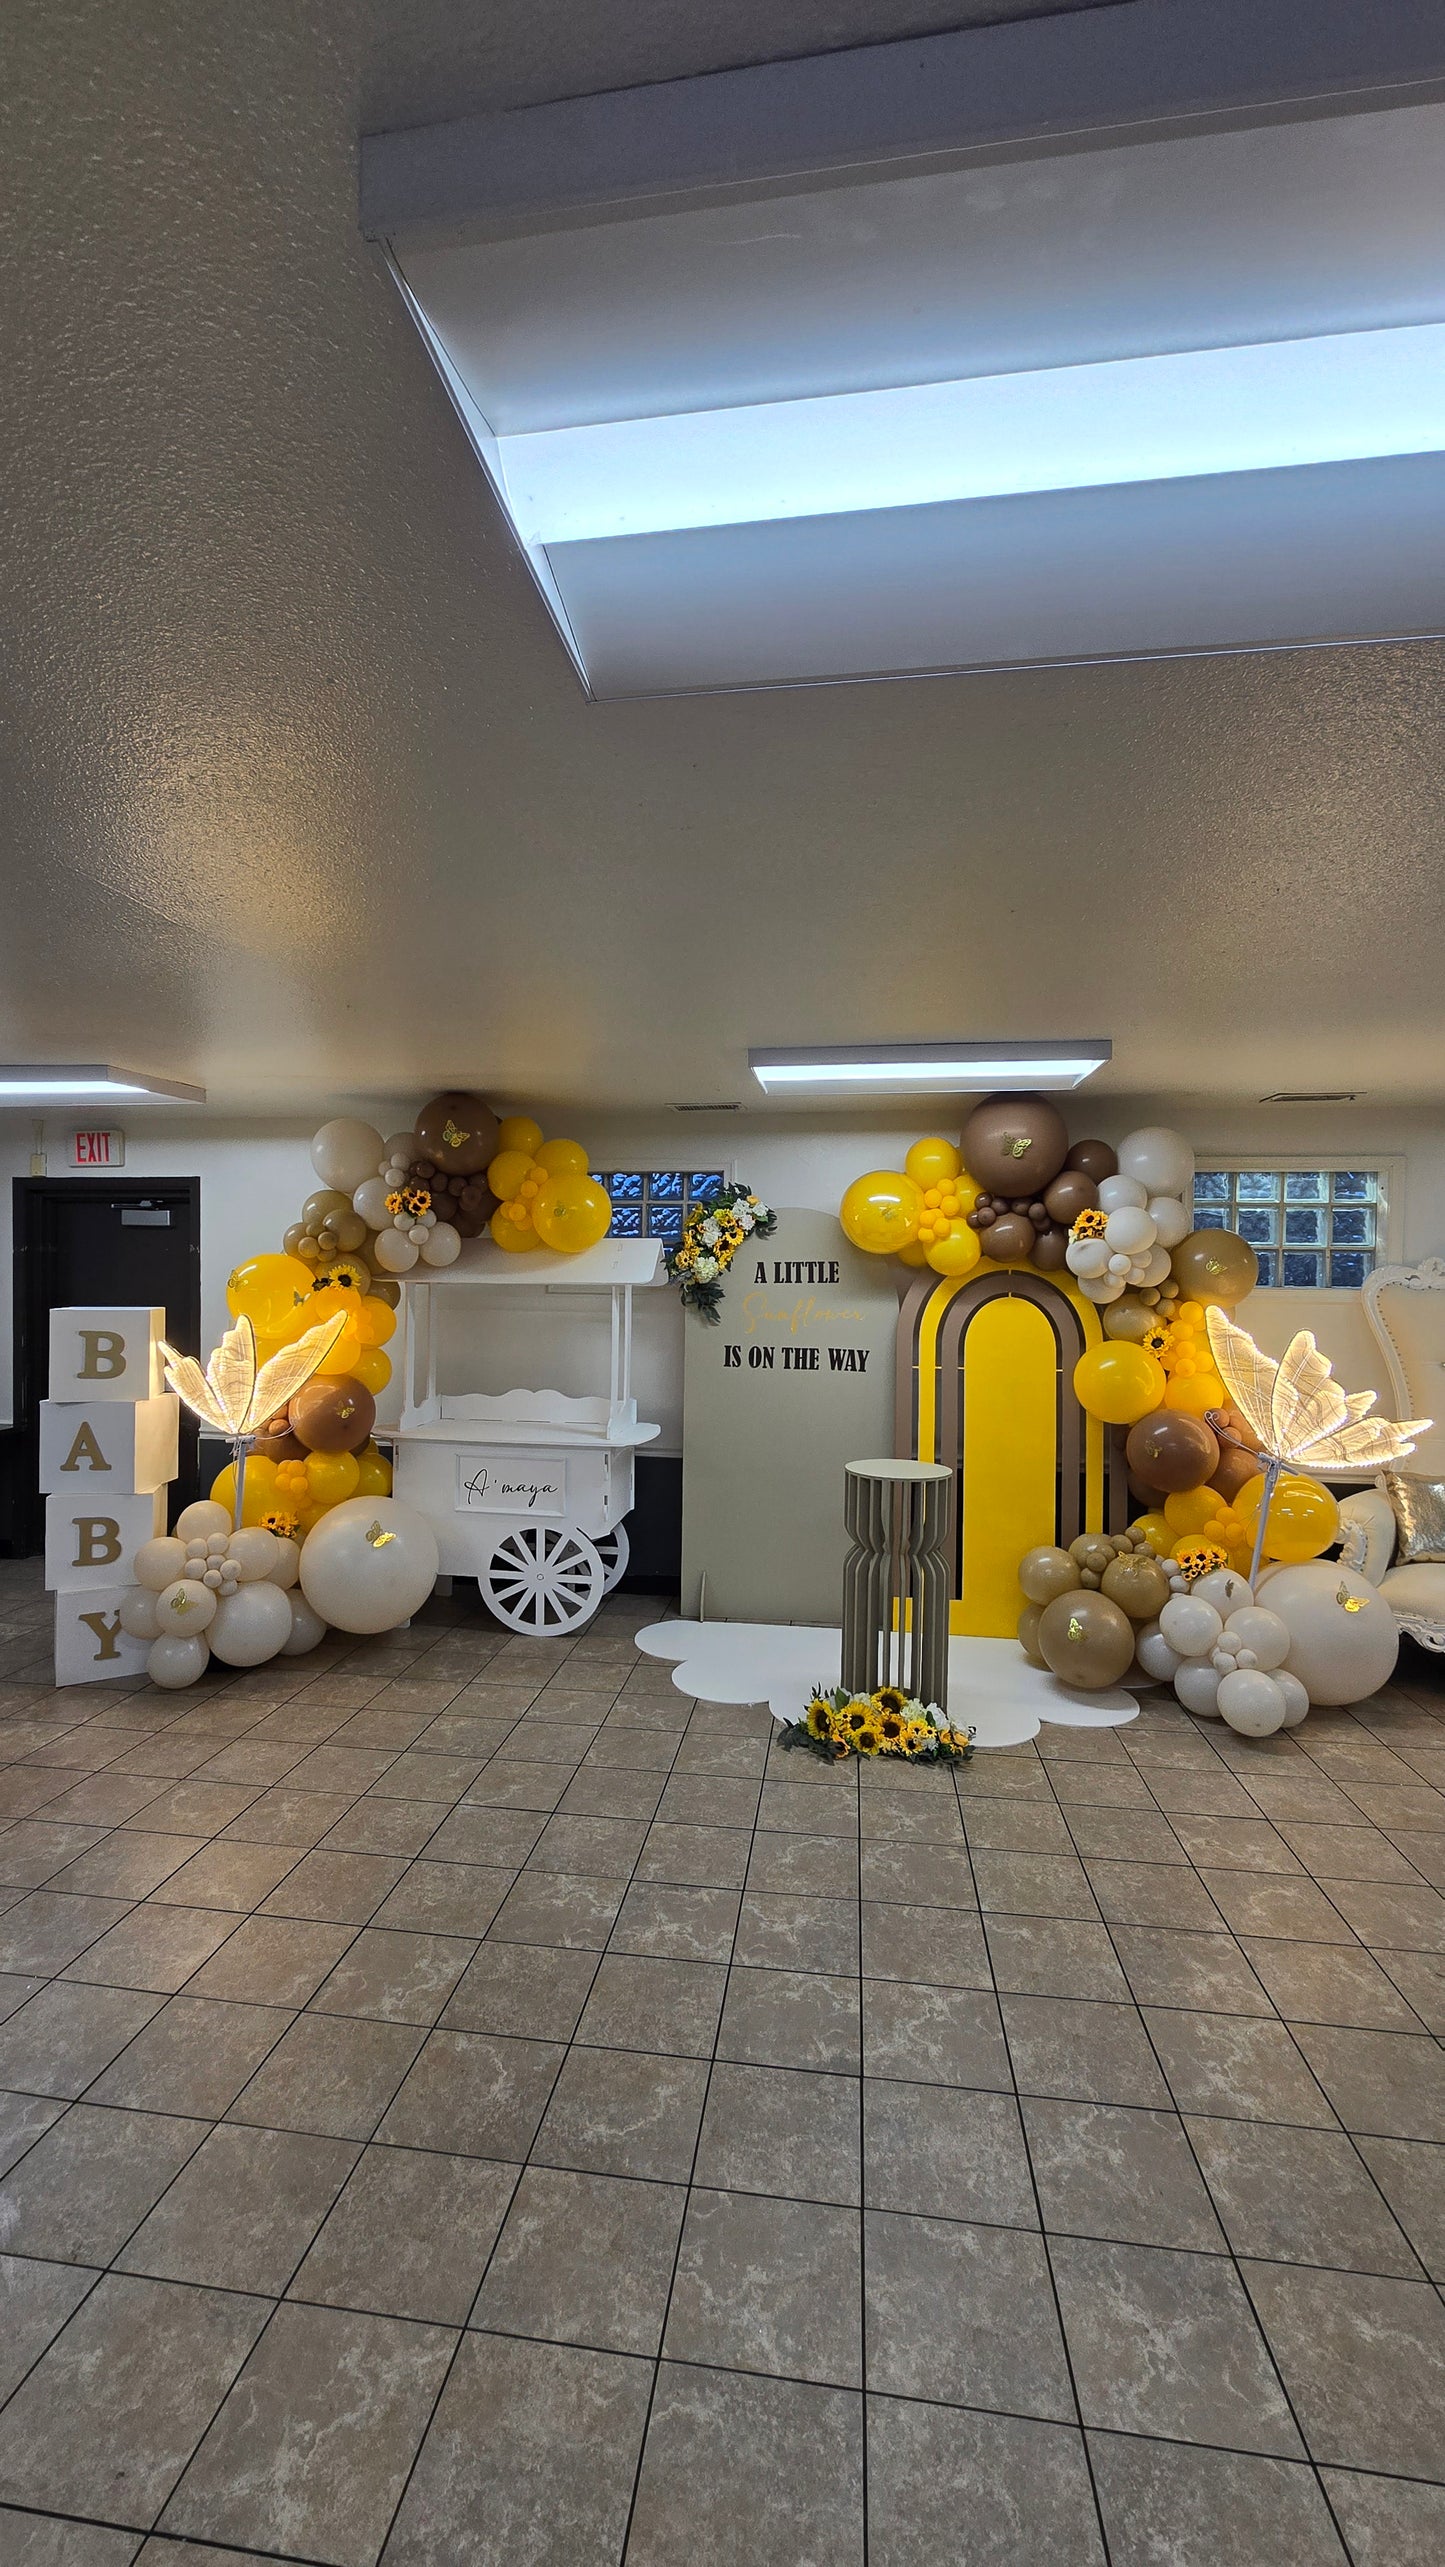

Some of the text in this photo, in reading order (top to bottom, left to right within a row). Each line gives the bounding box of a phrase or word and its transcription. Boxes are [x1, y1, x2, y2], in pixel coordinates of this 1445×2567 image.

[76, 1132, 111, 1164] EXIT
[754, 1261, 840, 1283] A LITTLE
[742, 1291, 865, 1335] Sunflower
[723, 1345, 870, 1372] IS ON THE WAY
[464, 1468, 558, 1507] A'maya
